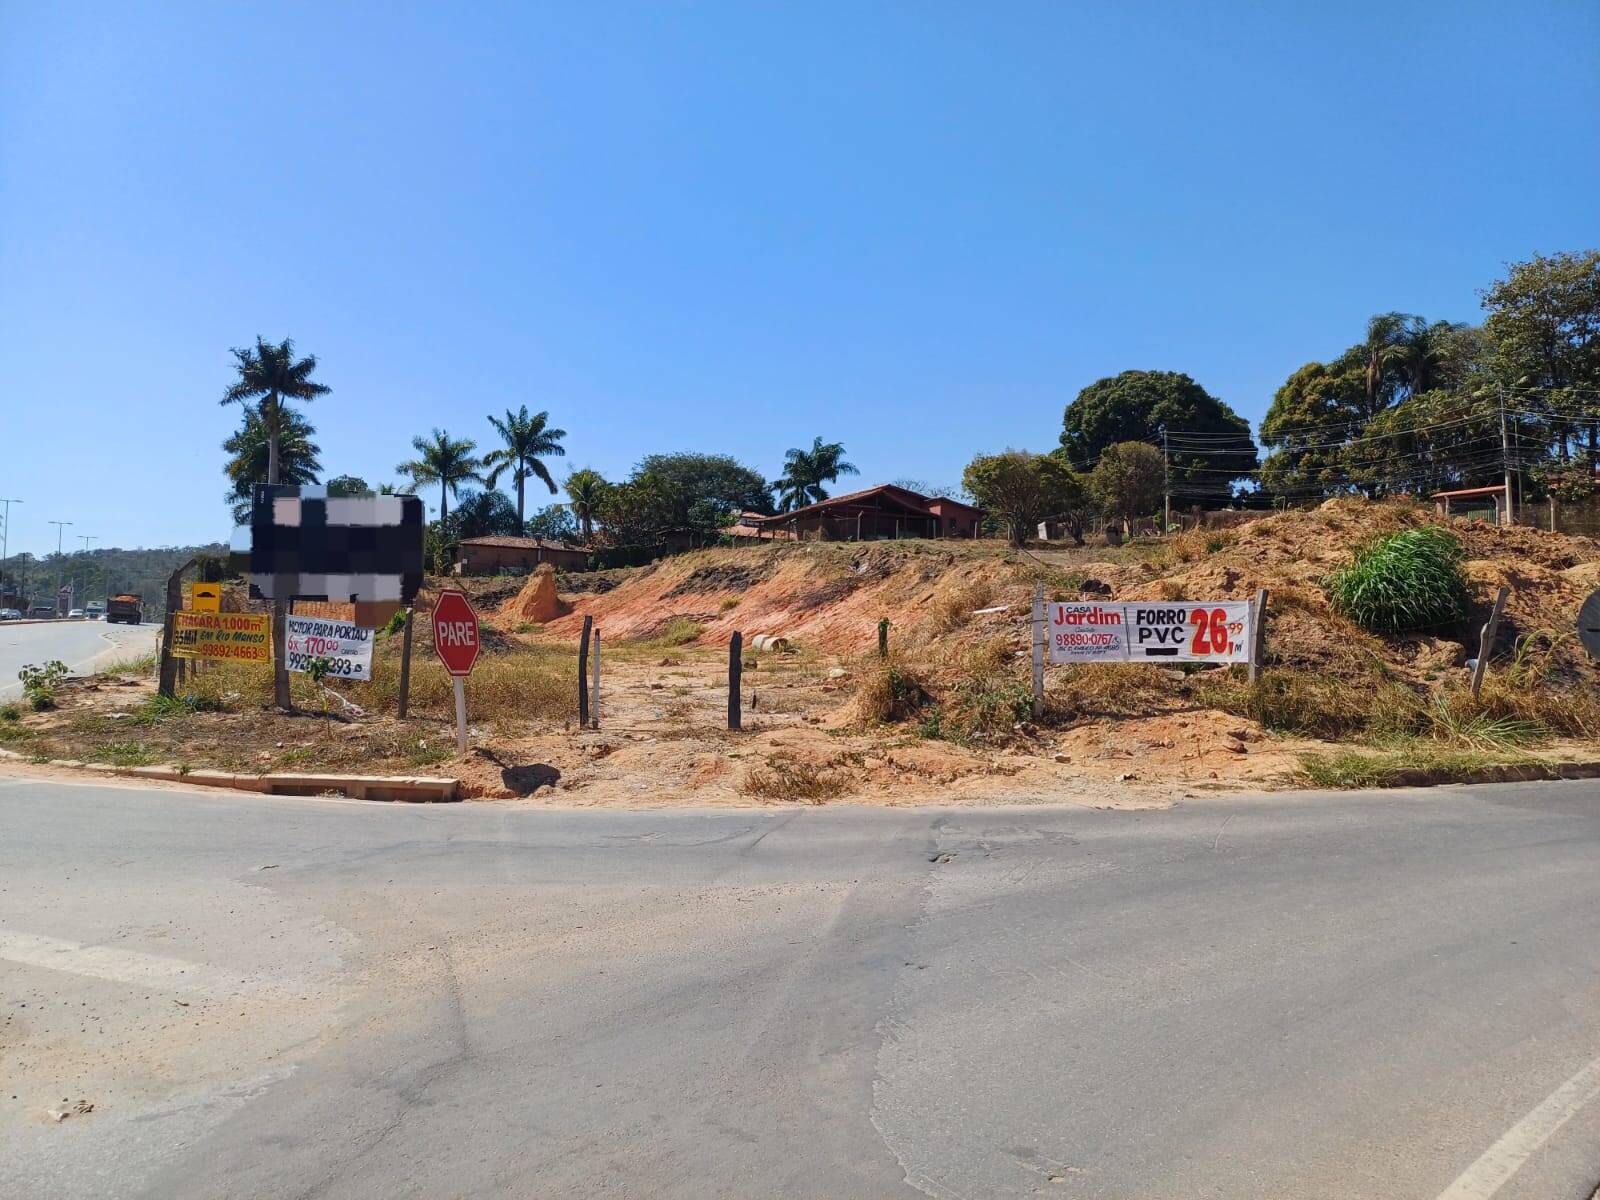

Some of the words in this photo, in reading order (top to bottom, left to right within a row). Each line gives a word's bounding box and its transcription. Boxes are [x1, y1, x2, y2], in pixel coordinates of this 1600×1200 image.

[1054, 606, 1121, 625] Jardim
[1136, 608, 1186, 625] FORRO
[289, 620, 313, 636] MOTOR
[312, 622, 334, 638] PARA
[438, 621, 475, 646] PARE
[1138, 626, 1185, 643] PVC
